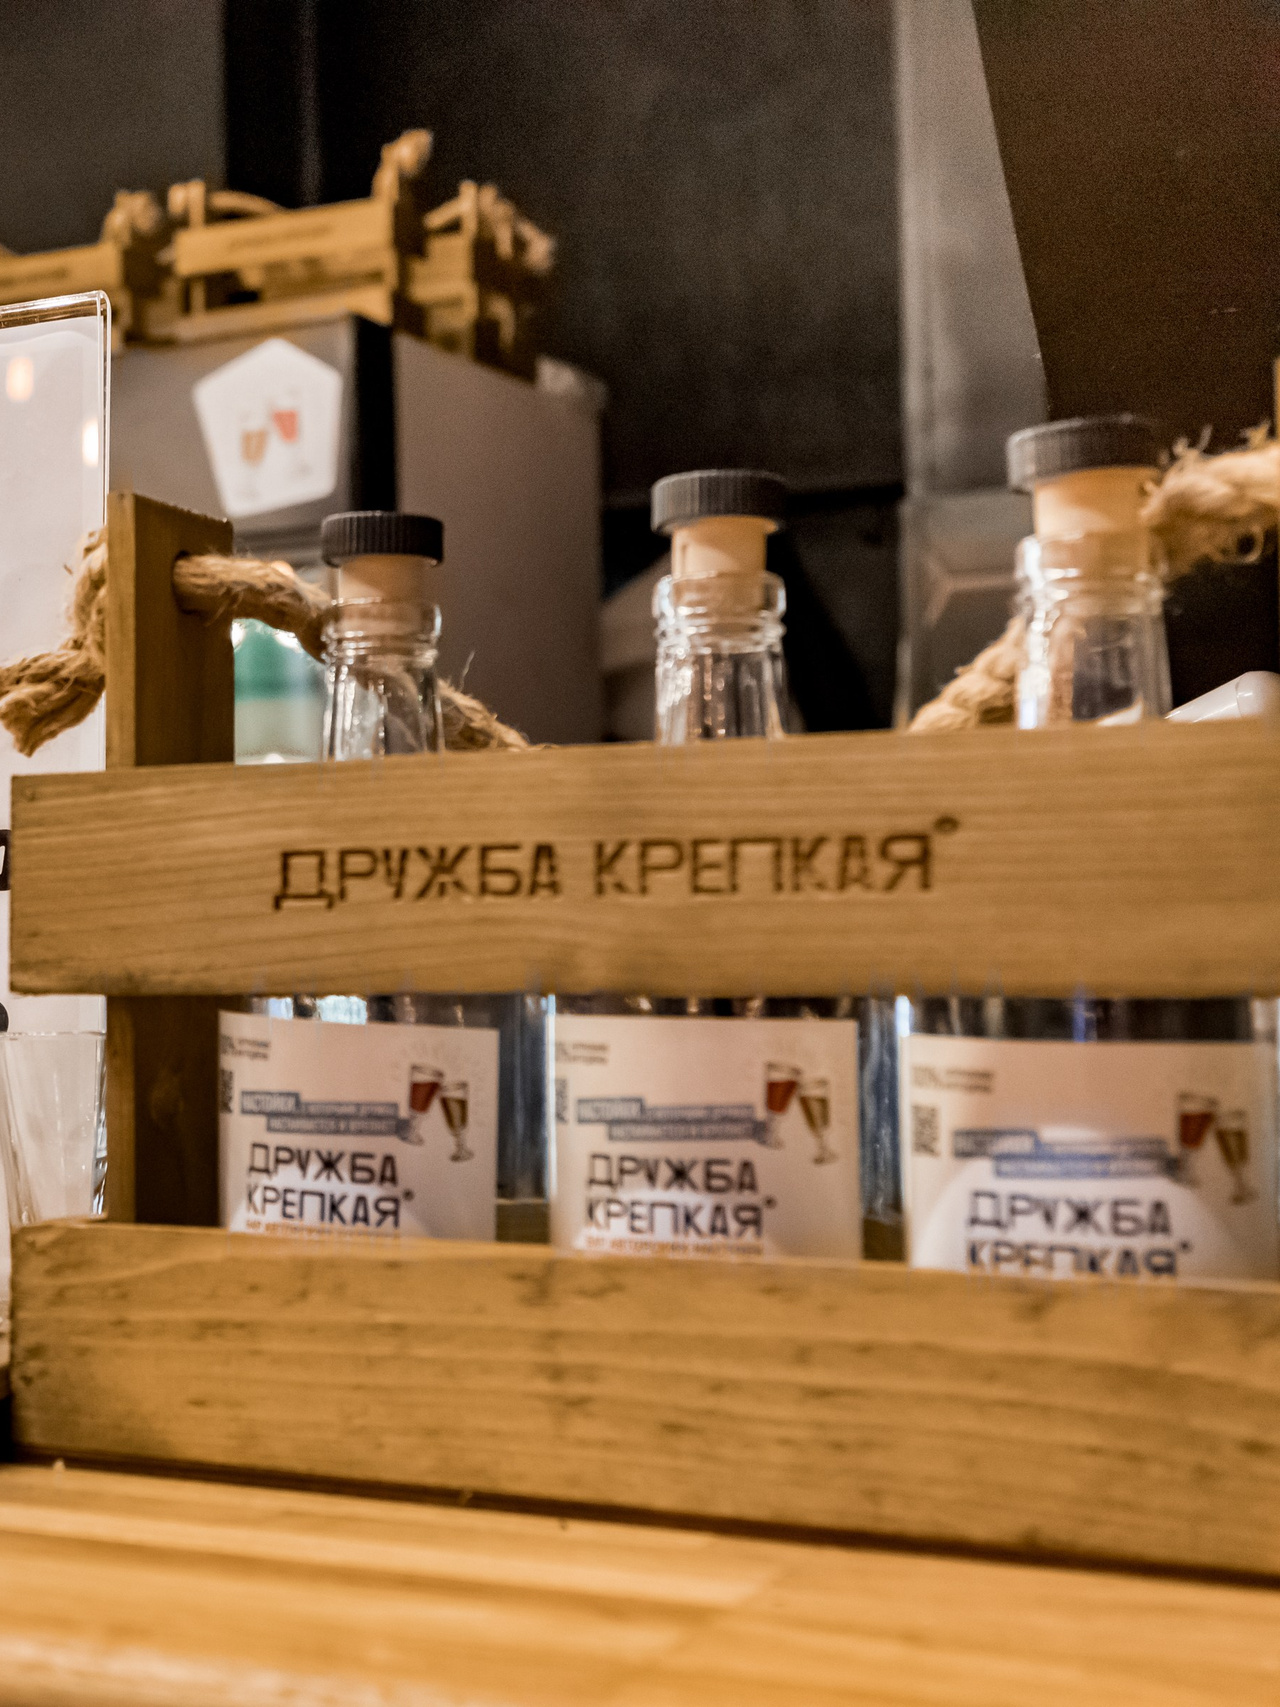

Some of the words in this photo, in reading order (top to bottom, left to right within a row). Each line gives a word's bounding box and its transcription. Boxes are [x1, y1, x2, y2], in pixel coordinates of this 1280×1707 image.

[274, 840, 562, 911] ДРУЖБА
[247, 1142, 399, 1188] ДРУЖБА
[586, 1152, 759, 1194] ДРУЖБА
[967, 1190, 1173, 1238] ДРУЖБА
